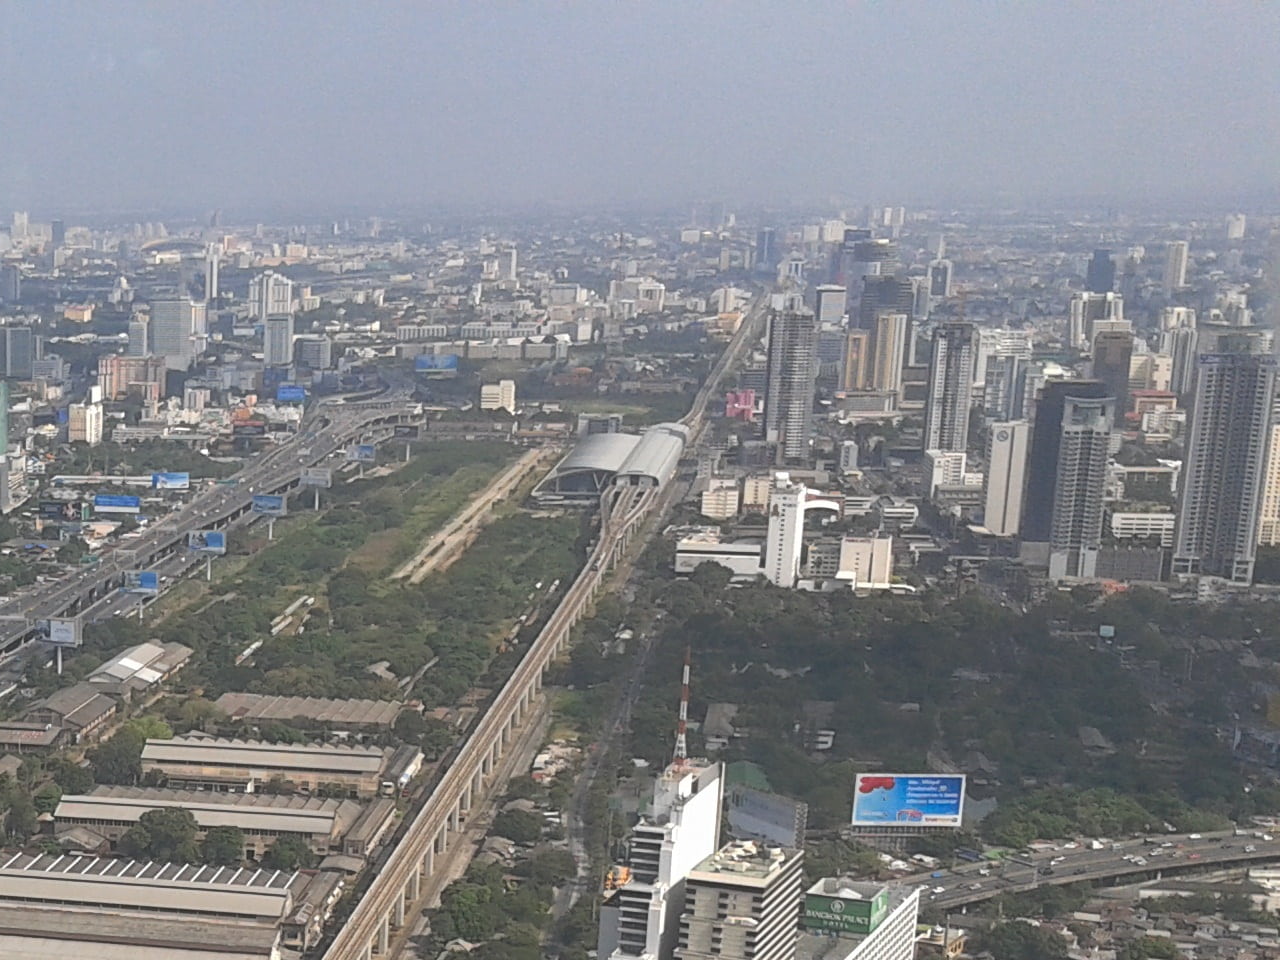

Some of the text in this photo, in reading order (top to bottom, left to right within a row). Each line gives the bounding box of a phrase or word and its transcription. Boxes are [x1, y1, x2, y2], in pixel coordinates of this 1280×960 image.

[806, 909, 841, 921] BANGKOK
[842, 914, 869, 925] PALACE
[823, 920, 849, 929] HOTEL
